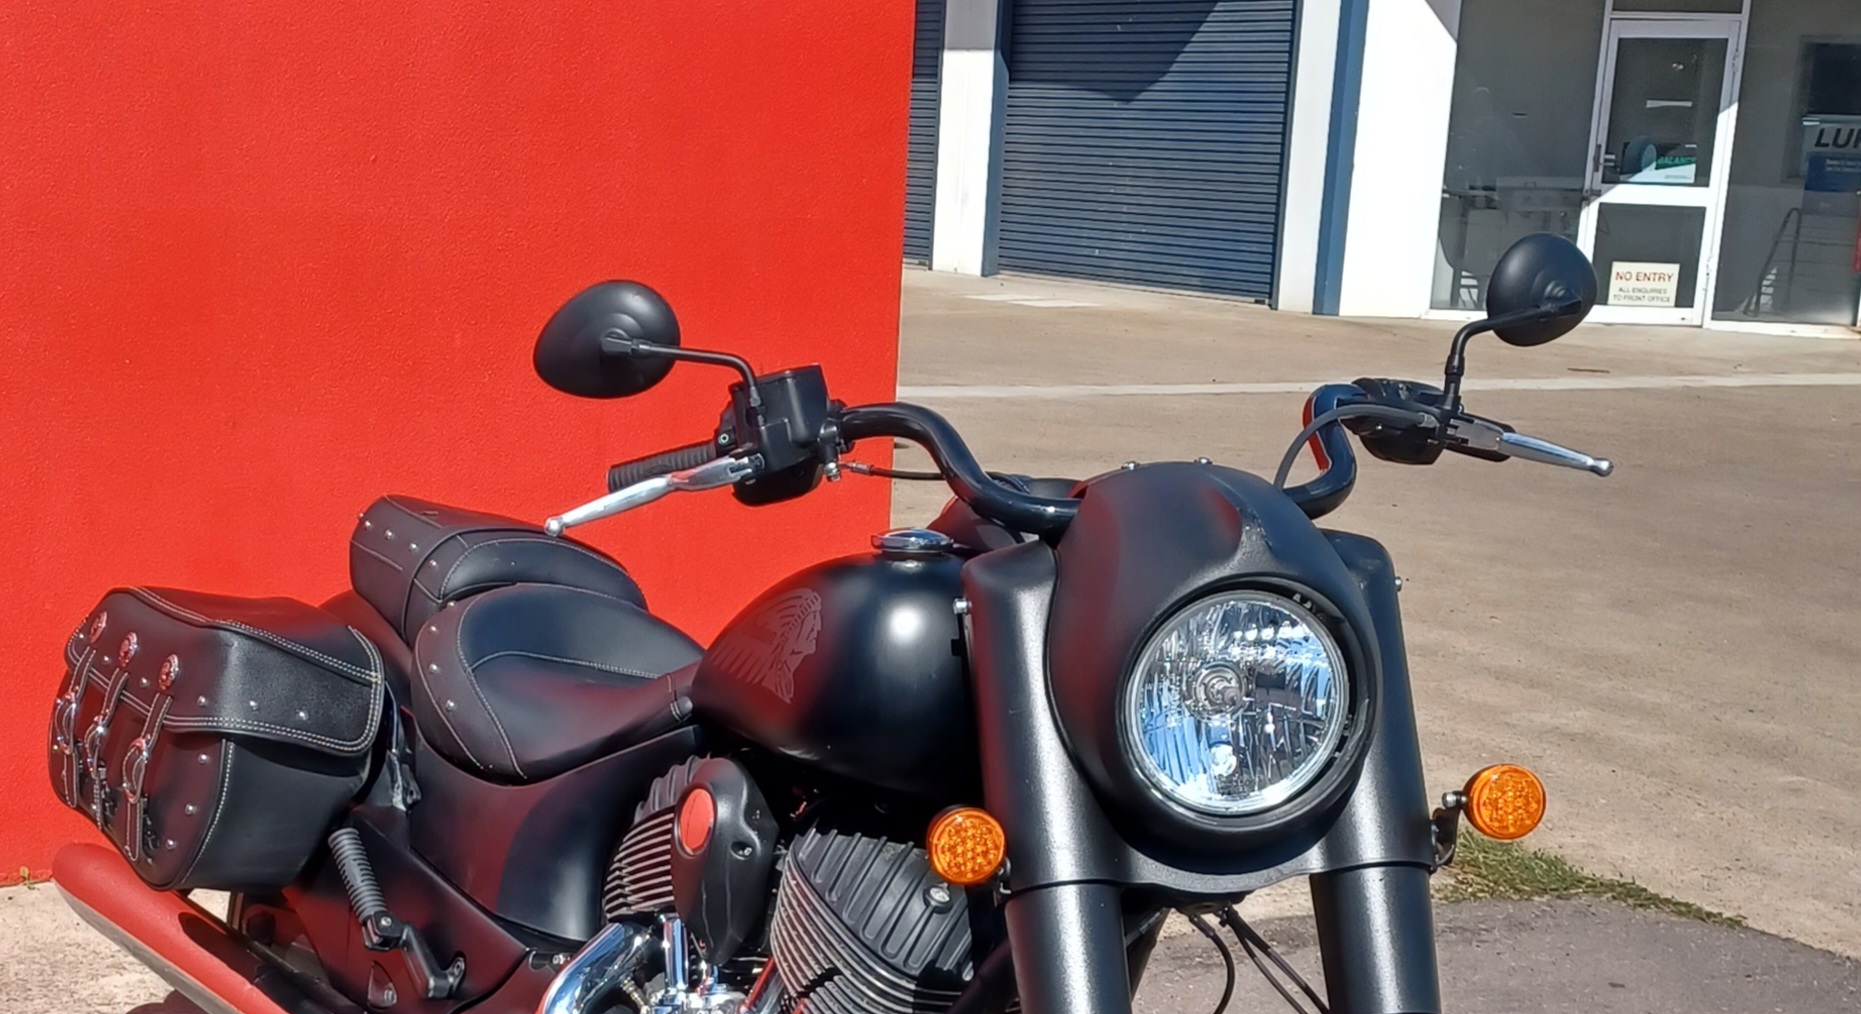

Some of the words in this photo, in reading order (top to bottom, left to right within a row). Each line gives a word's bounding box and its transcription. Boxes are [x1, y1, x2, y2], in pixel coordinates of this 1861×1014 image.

[1615, 271, 1633, 281] NO
[1635, 271, 1674, 282] ENTRY
[1623, 294, 1646, 302] FRONT
